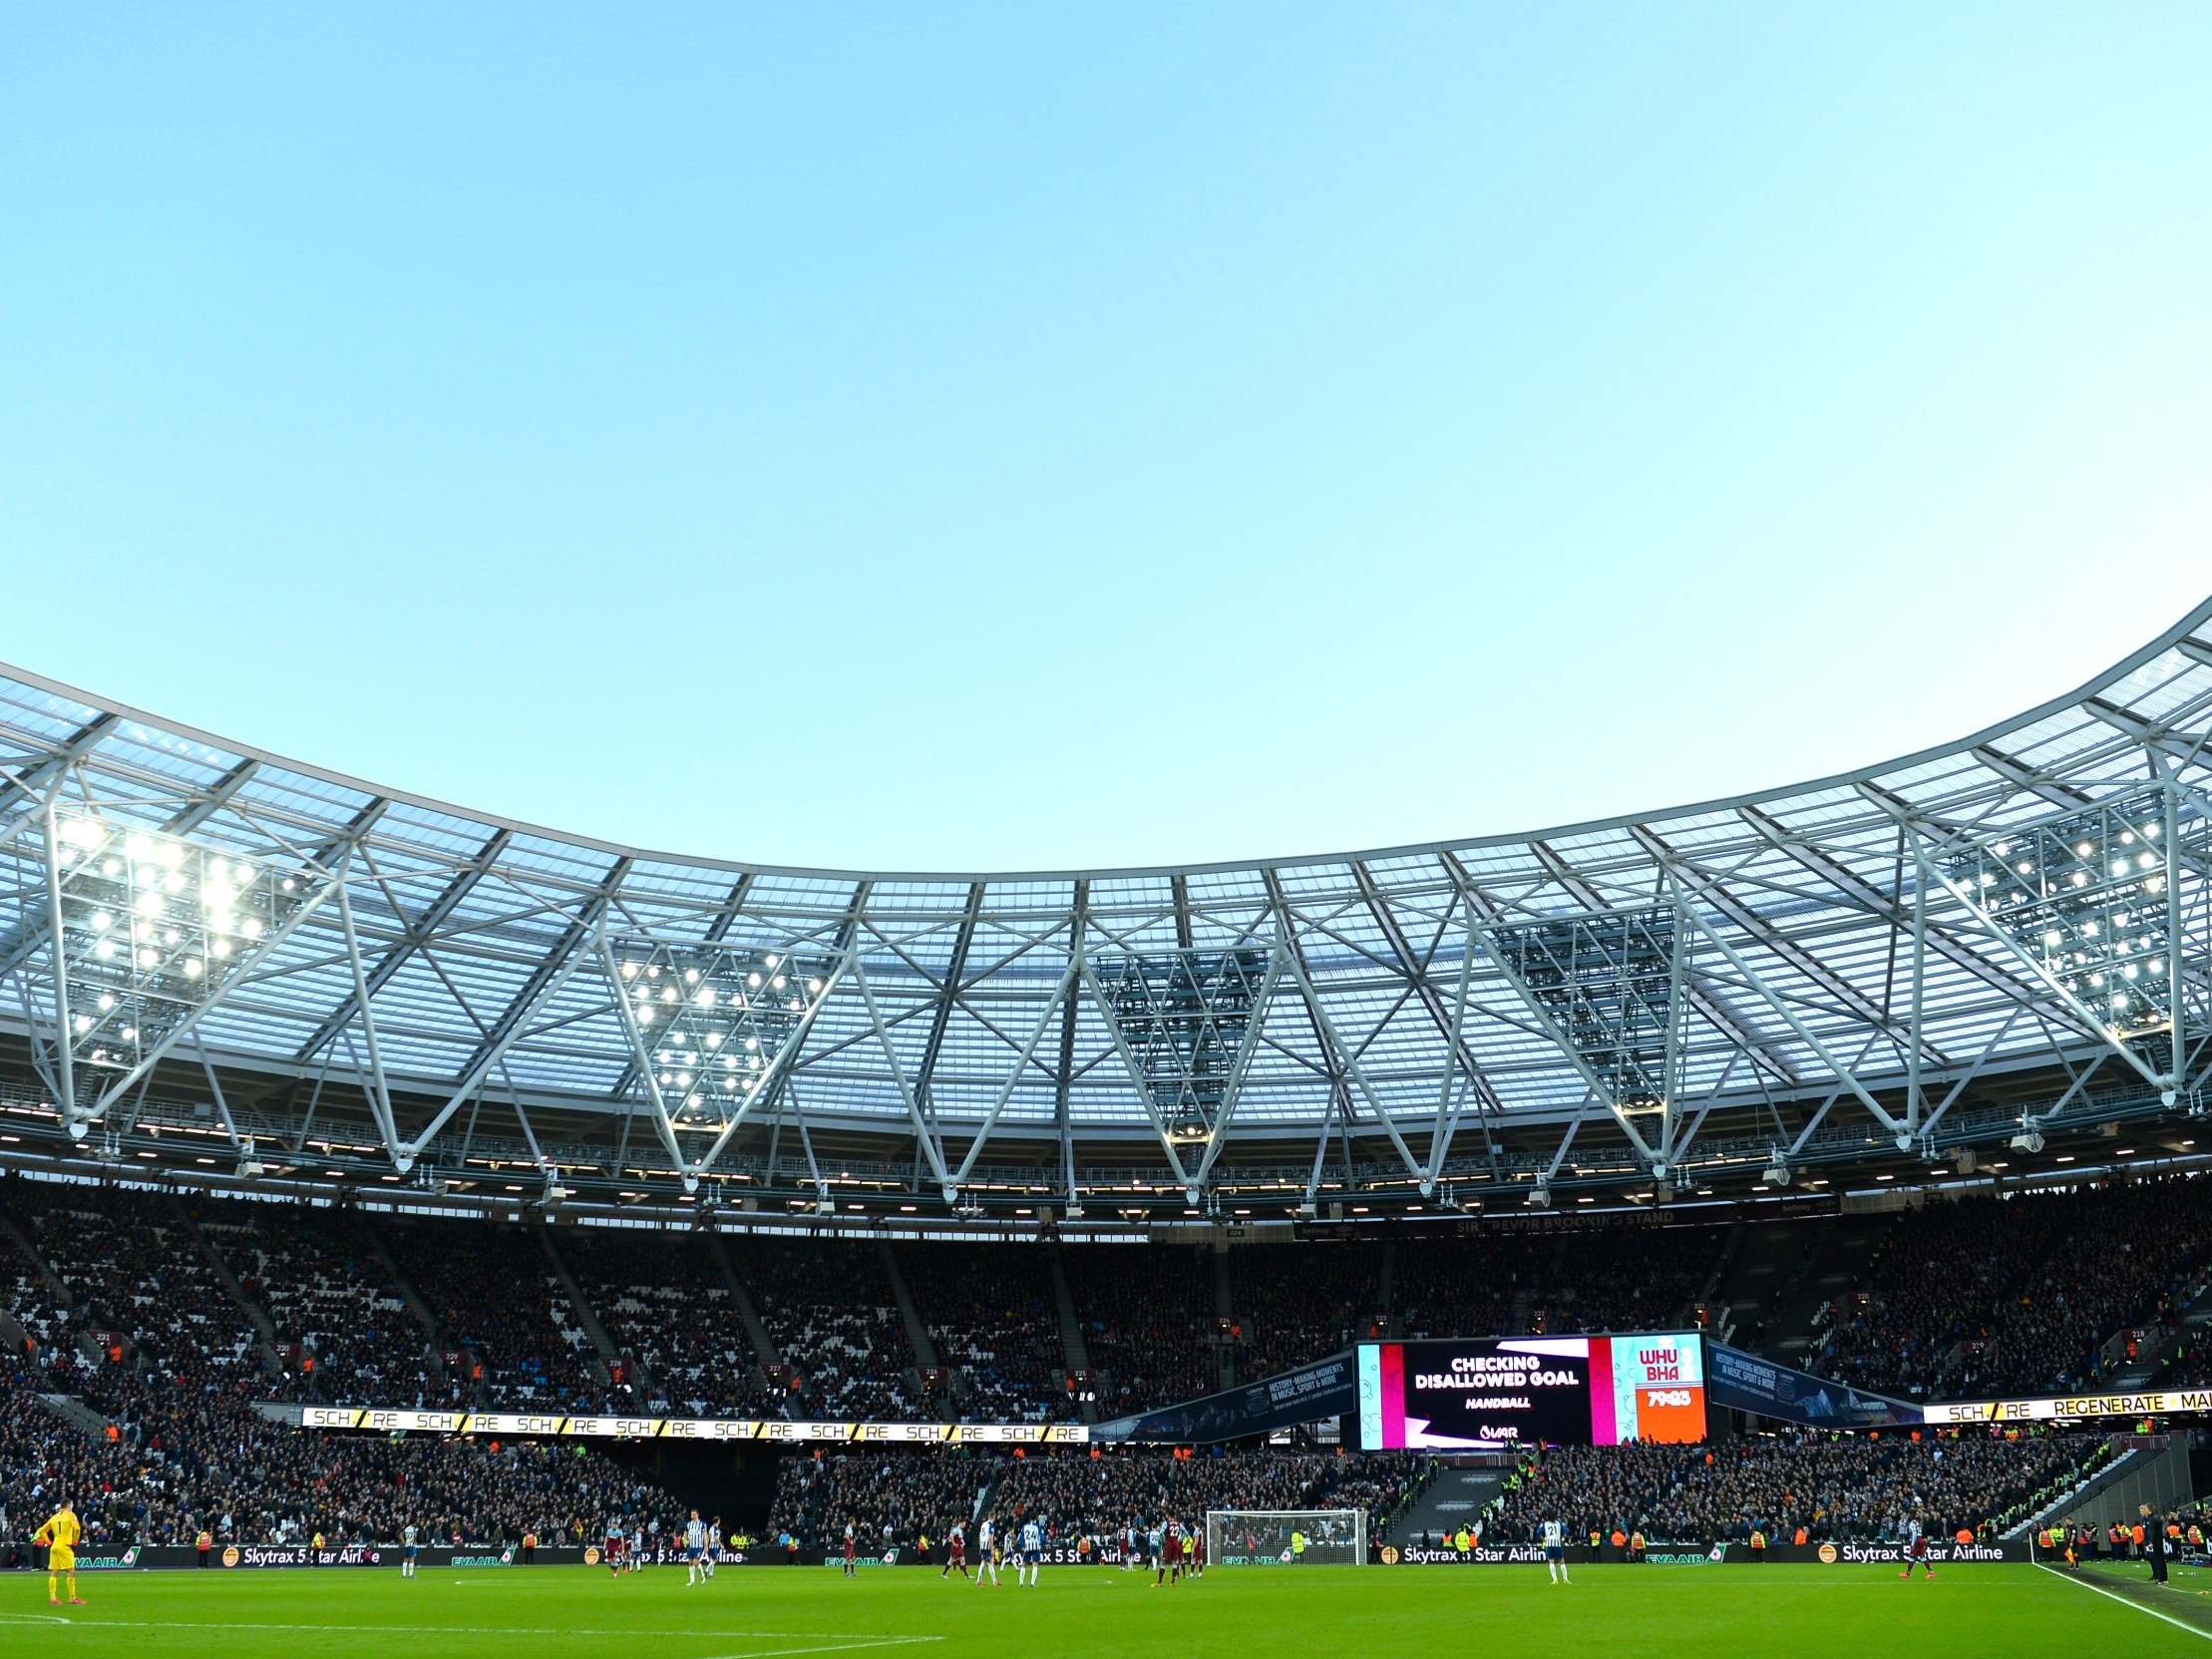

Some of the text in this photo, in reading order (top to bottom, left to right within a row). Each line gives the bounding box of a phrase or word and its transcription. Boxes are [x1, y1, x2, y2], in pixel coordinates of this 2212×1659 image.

[1457, 1221, 1479, 1233] SIR
[1626, 1212, 1674, 1226] STAND
[1451, 1356, 1541, 1373] CHECKING
[1640, 1349, 1677, 1364] WHU
[1269, 1370, 1316, 1392] HISTORY-MAKING
[1315, 1363, 1344, 1379] MOMENTS
[1415, 1371, 1580, 1389] DISALLOWED GOAL
[1647, 1366, 1679, 1382] BHA
[1271, 1392, 1279, 1402] IN
[1296, 1382, 1315, 1395] SPORT
[1320, 1374, 1337, 1387] MORE
[1465, 1398, 1531, 1410] HANDBALL
[2053, 1395, 2165, 1417] REGENERATE
[1491, 1428, 1518, 1439] VAR
[1025, 1529, 1037, 1540] 24
[1169, 1525, 1180, 1537] 22
[1548, 1524, 1558, 1536] 21
[243, 1548, 380, 1567] Skytrax 5 tar Airle
[1054, 1549, 1064, 1563] 5
[1100, 1549, 1141, 1563] Airle
[1404, 1547, 1457, 1564] Skytrax
[1475, 1547, 1504, 1561] Star
[1508, 1547, 1546, 1561] Airlin
[1843, 1544, 1899, 1563] Skytrax
[1925, 1545, 1949, 1560] tar
[1953, 1544, 2004, 1560] Airline
